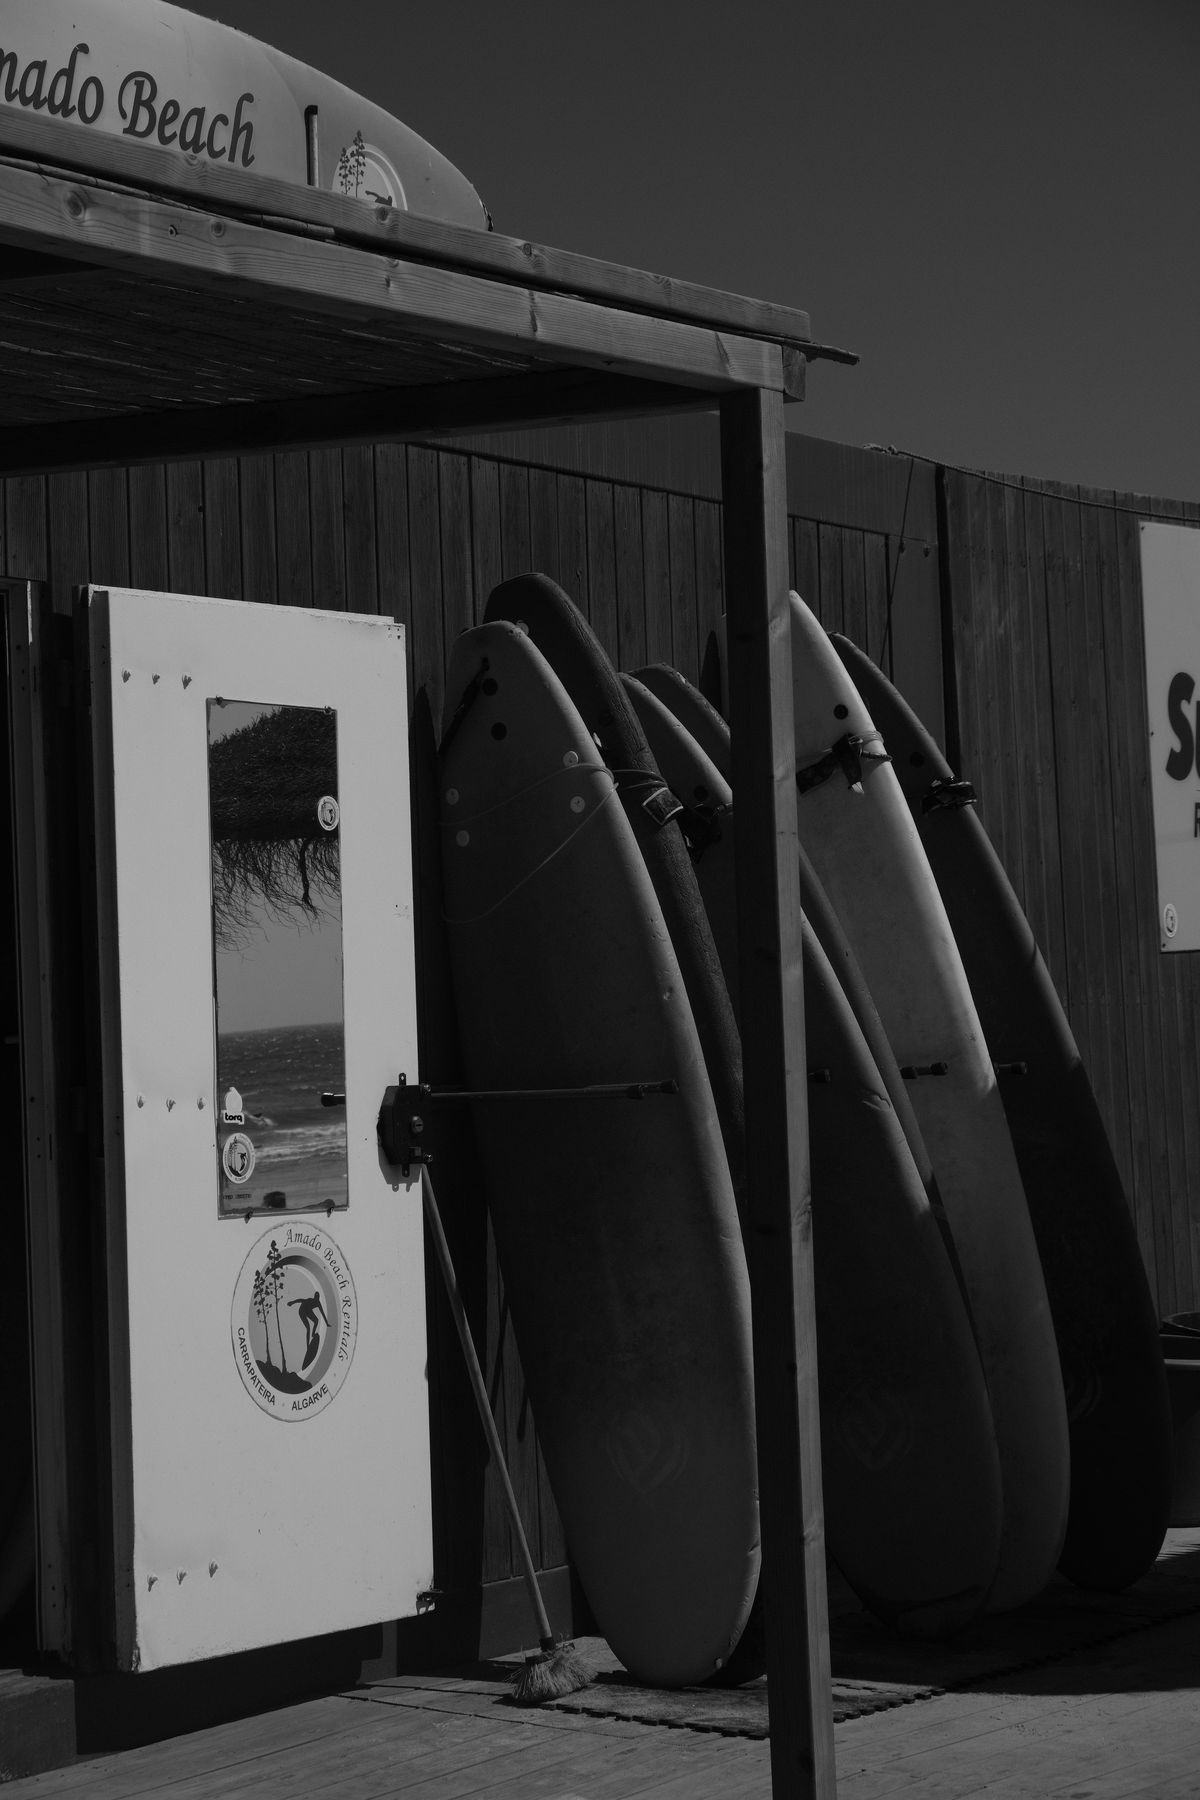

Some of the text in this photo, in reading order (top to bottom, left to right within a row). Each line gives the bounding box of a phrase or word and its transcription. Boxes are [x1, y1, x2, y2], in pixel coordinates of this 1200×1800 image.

[118, 71, 255, 167] Beach
[1165, 671, 1200, 782] S
[224, 1112, 243, 1123] torq
[284, 1228, 352, 1362] Amado Beach Rentals
[237, 1326, 329, 1411] CARRAPATEIRA ALGARVE
